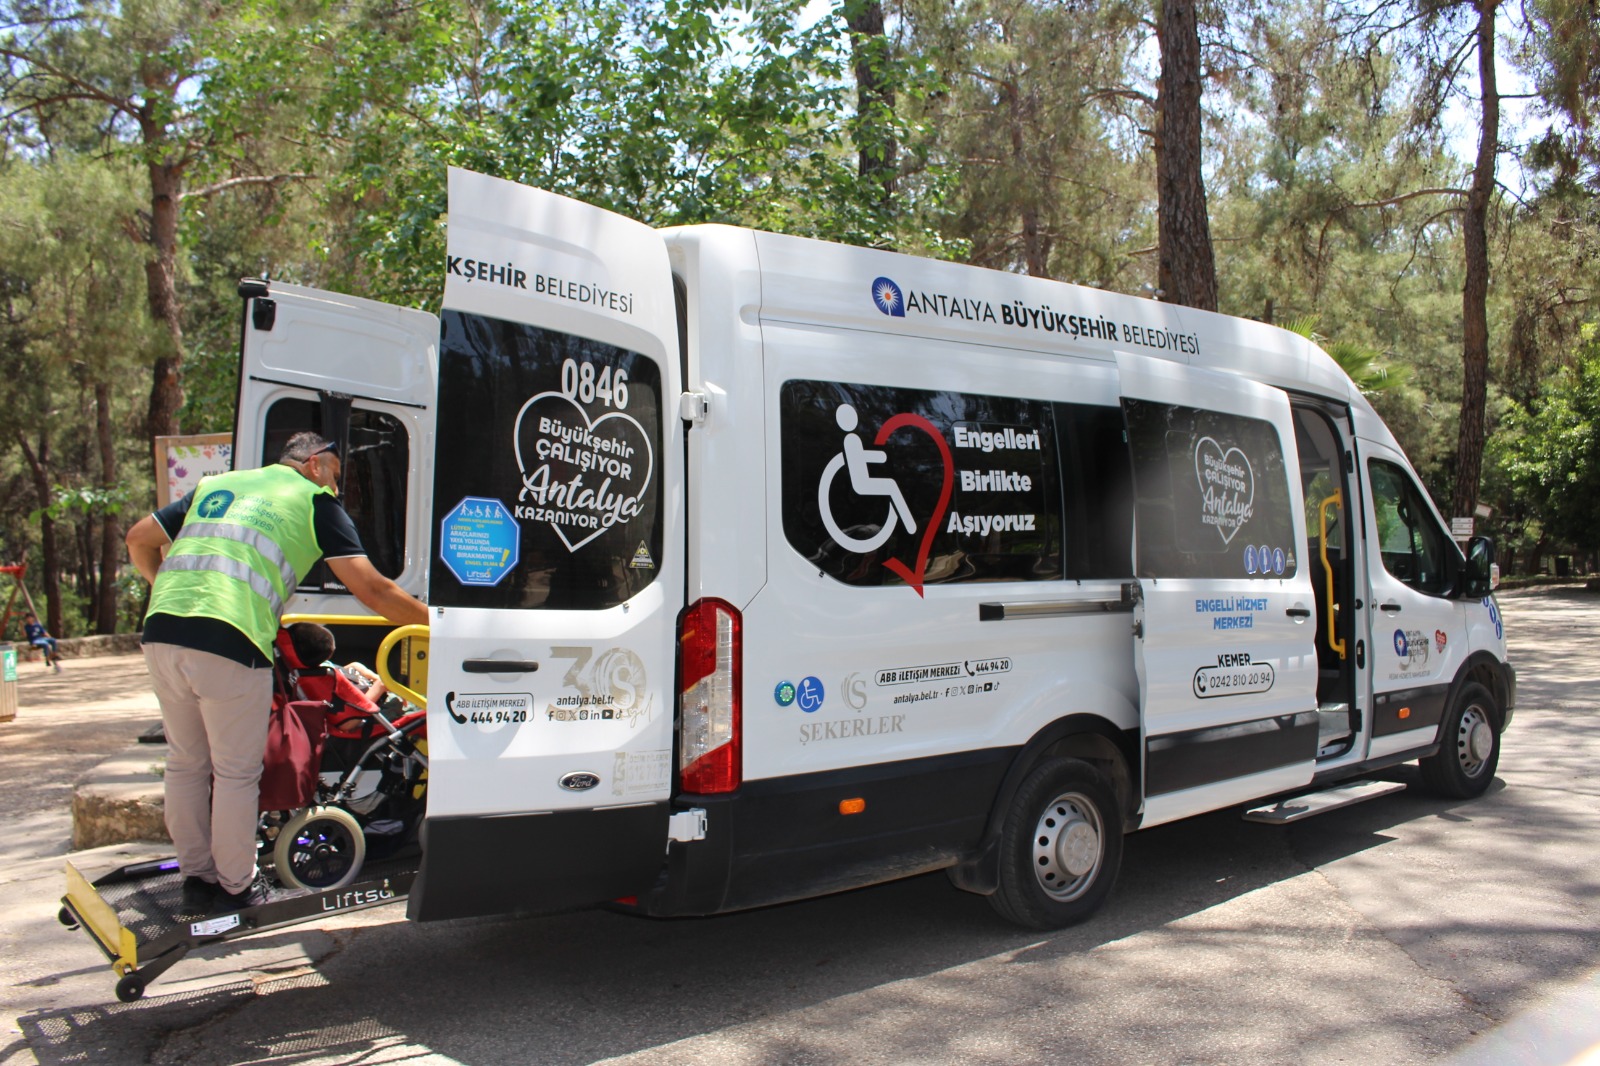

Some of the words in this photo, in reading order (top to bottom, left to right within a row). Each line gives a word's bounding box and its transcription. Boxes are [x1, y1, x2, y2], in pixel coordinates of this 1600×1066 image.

[447, 255, 527, 289] KŞEHİR
[535, 274, 633, 315] BELEDİYESİ
[906, 290, 996, 323] ANTALYA
[1001, 300, 1118, 341] BÜYÜKŞEHİR
[1123, 323, 1200, 355] BELEDİYESİ
[561, 358, 628, 409] 0846
[539, 417, 634, 458] Büyükşehir
[953, 426, 1040, 452] Engelleri
[535, 439, 631, 480] ÇALIŞIYOR
[1203, 453, 1245, 478] Büyükşehir
[960, 469, 1032, 492] Birlikte
[1205, 468, 1246, 493] ÇALIŞIYOR
[518, 464, 644, 528] Antalya
[1202, 486, 1253, 527] Antalya
[514, 505, 598, 529] KAZANIYOR
[946, 511, 1036, 537] Aşıyoruz
[1195, 596, 1234, 612] ENGELLİ
[1236, 596, 1268, 611] HİZMET
[1213, 613, 1253, 630] MERKEZİ
[880, 673, 897, 683] ABB
[930, 665, 961, 678] MERKEZİ
[975, 663, 989, 672] 444
[990, 661, 999, 671] 94
[1000, 660, 1009, 669] 20
[1217, 653, 1251, 668] KEMER
[1210, 675, 1231, 688] 0242
[1233, 674, 1247, 686] 810
[1248, 673, 1259, 685] 20
[1260, 672, 1271, 684] 94
[456, 700, 471, 708] ABB
[472, 698, 497, 709] İLETİŞİM
[498, 698, 527, 707] MERKEZİ
[556, 695, 615, 707] antalya.bel.tr
[893, 690, 938, 704] antalya.bel.tr
[471, 712, 493, 724] 444
[496, 711, 510, 723] 94
[512, 710, 527, 722] 20
[569, 776, 594, 789] Ford
